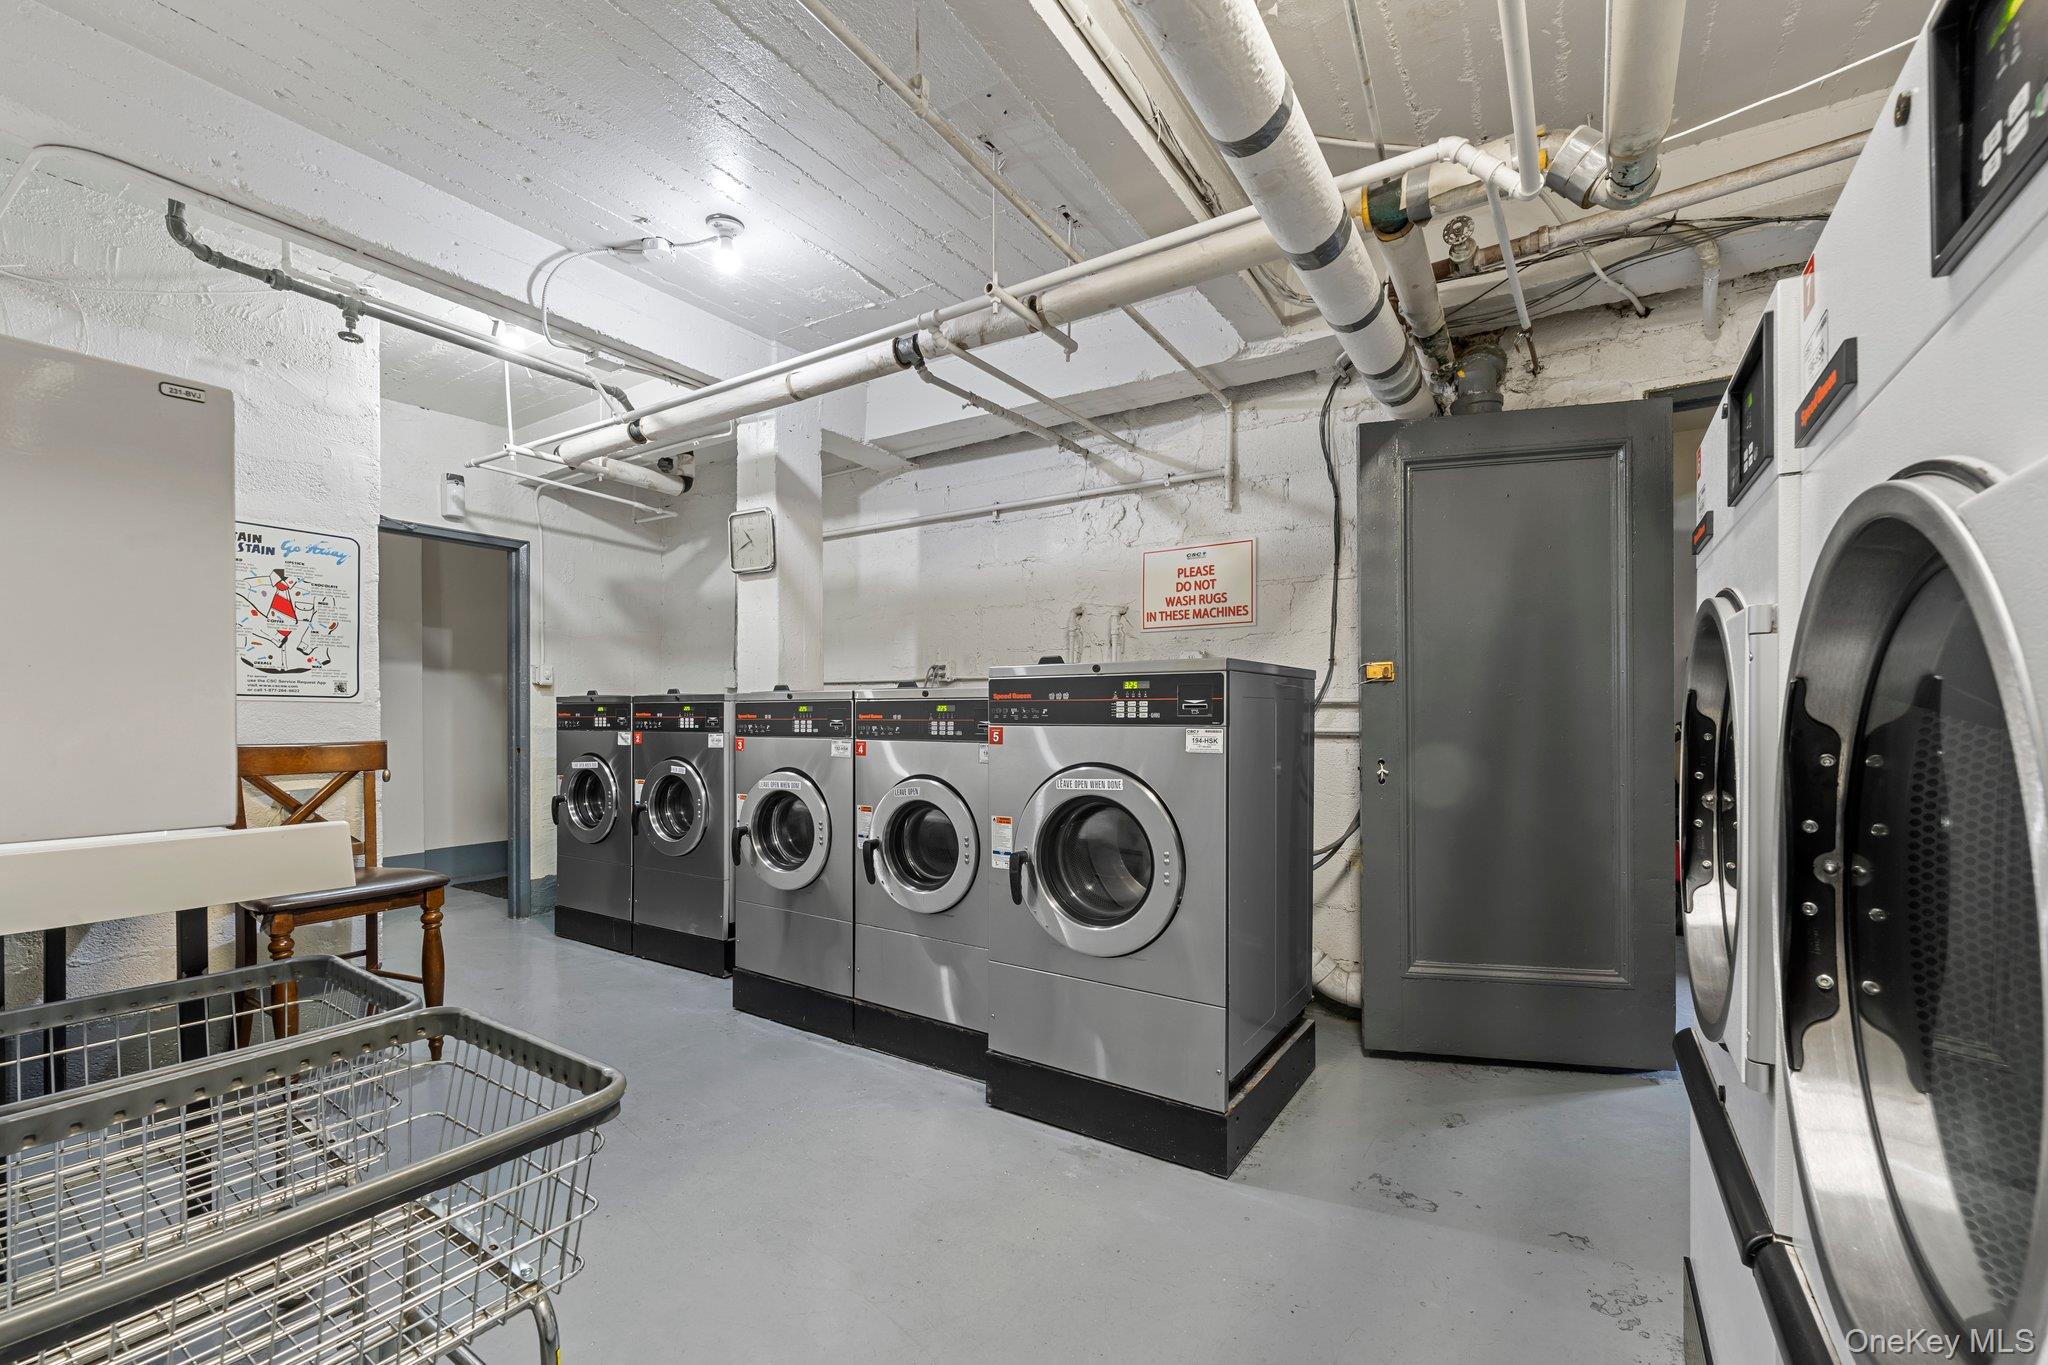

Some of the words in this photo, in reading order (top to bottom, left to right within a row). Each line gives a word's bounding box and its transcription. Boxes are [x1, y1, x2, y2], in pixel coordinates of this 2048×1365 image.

[235, 532, 262, 543] AIN
[237, 543, 275, 556] STAIN
[281, 540, 300, 557] Go
[1177, 565, 1215, 578] PLEASE
[1175, 581, 1191, 592] DO
[1194, 579, 1216, 590] NOT
[1165, 595, 1196, 607] WASH
[1199, 592, 1227, 604] RUGS
[1146, 612, 1156, 622] IN
[1159, 610, 1190, 621] THESE
[1192, 605, 1249, 619] MACHINES
[993, 732, 999, 742] 5
[738, 741, 743, 749] 3
[858, 745, 863, 753] 4
[1057, 779, 1073, 789] LEAVE
[1074, 779, 1088, 789] OPEN
[1090, 780, 1105, 789] WHEN
[1107, 780, 1122, 790] DONE
[894, 788, 907, 796] LEAVE
[908, 787, 919, 796] OPEN
